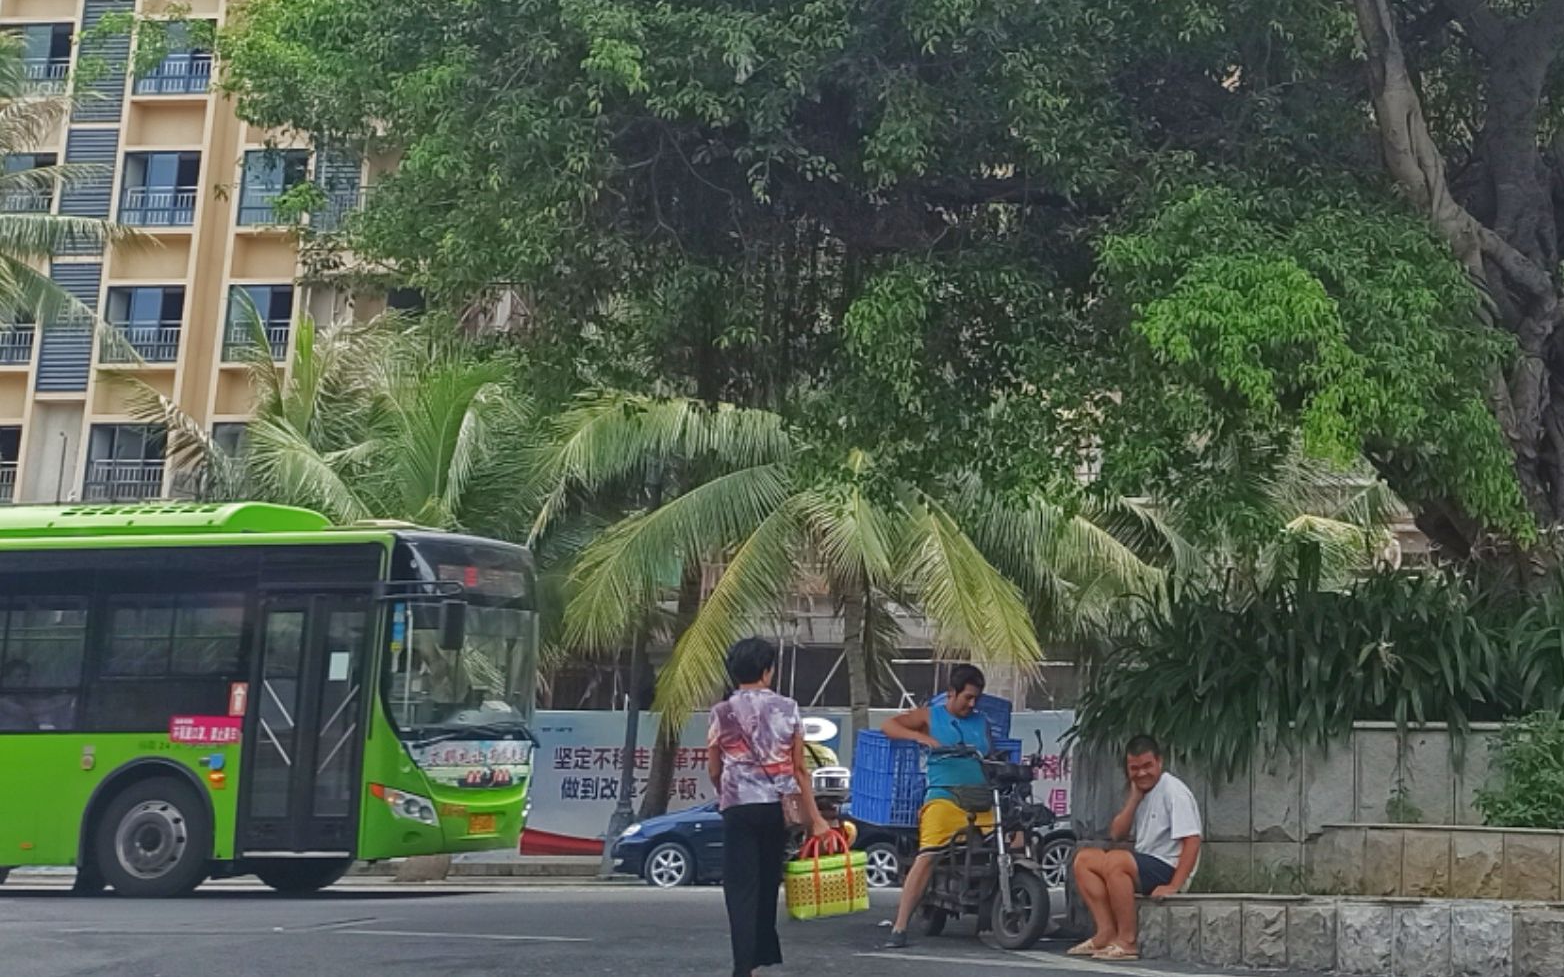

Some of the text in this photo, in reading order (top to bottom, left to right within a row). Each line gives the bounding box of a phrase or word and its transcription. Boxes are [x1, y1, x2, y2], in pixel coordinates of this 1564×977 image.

[554, 747, 709, 770] 坚定不移走革开
